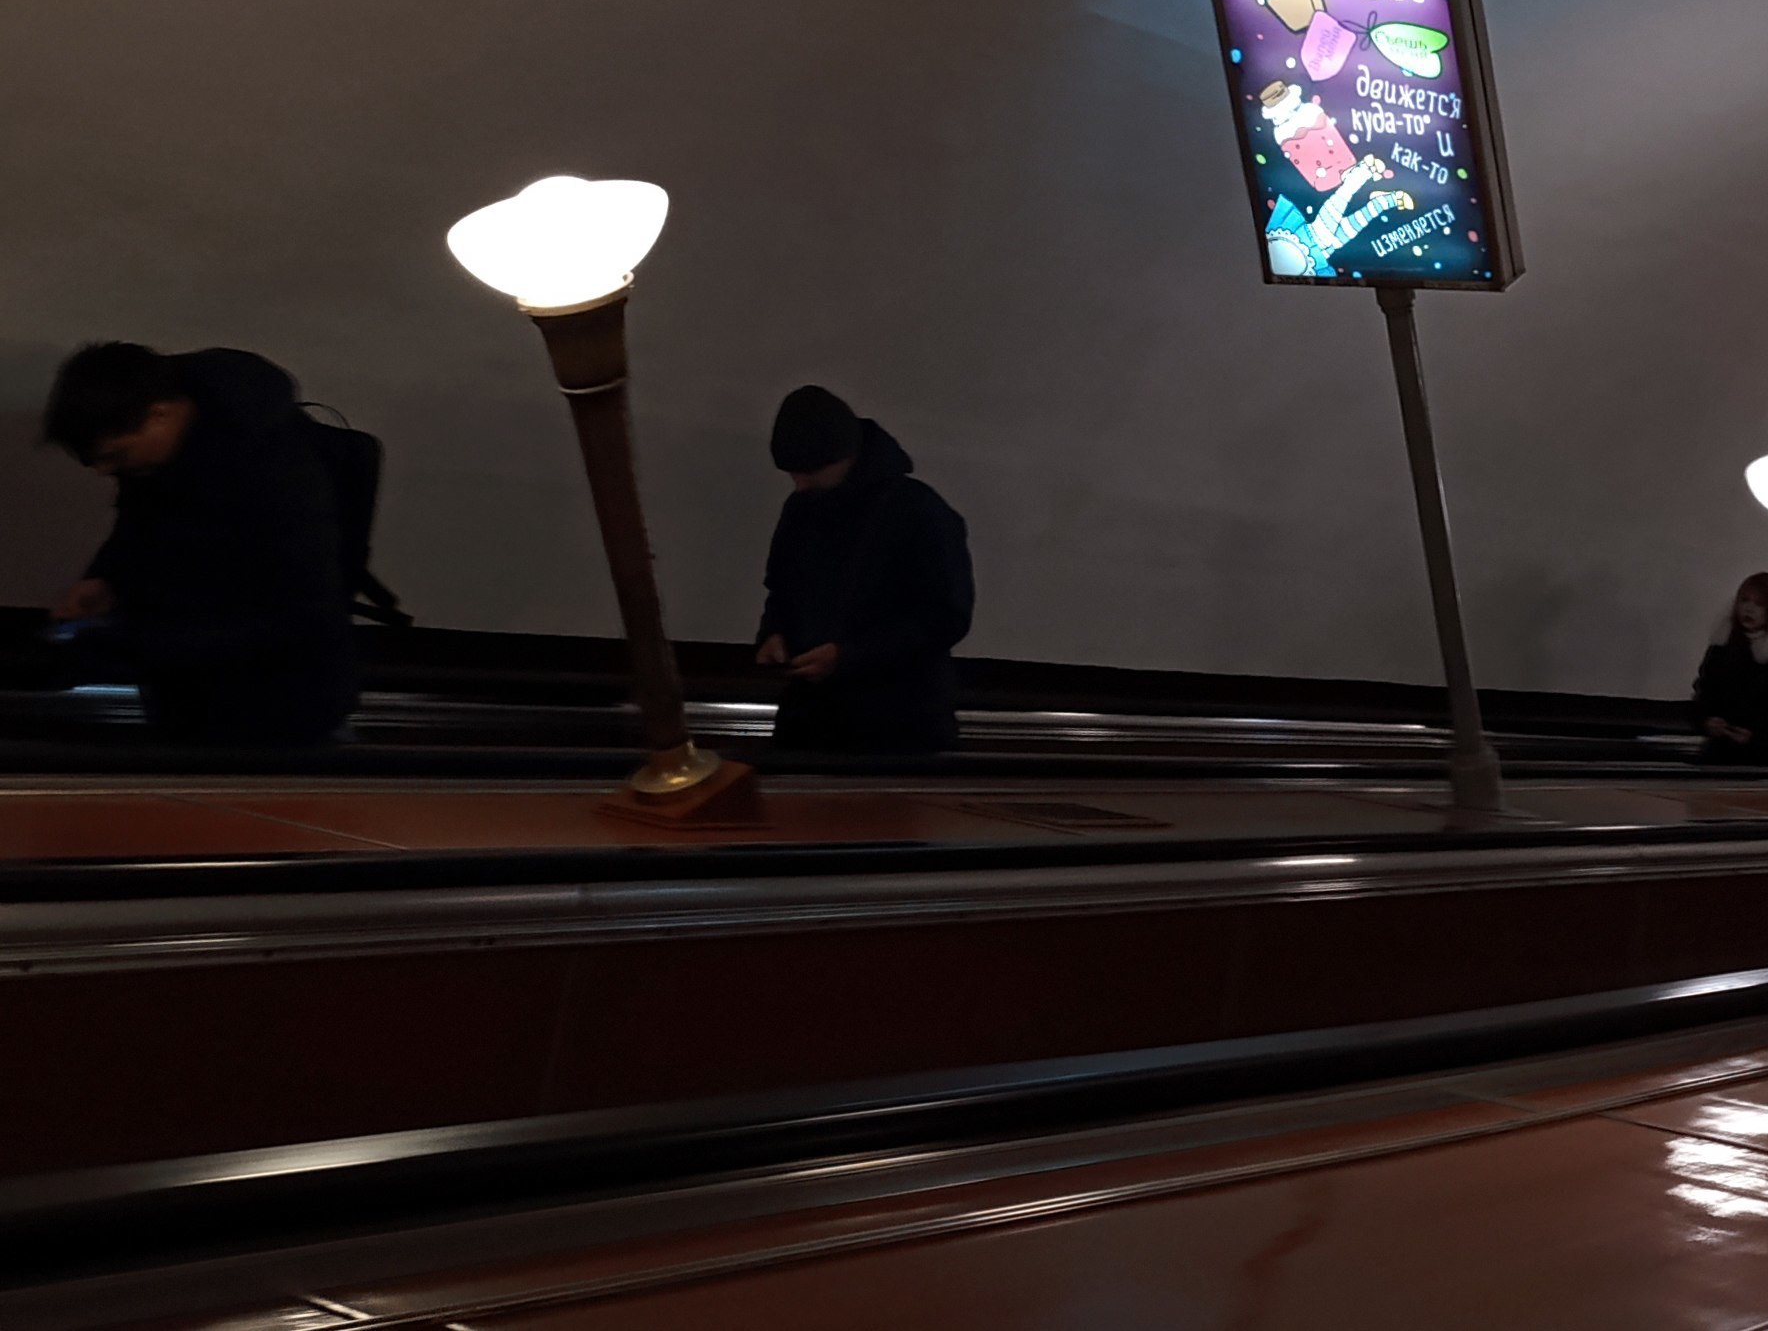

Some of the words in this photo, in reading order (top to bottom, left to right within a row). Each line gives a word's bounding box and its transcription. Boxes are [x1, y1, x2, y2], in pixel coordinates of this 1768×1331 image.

[1356, 64, 1462, 120] движется
[1351, 102, 1426, 143] куда-то
[1436, 130, 1455, 157] и
[1391, 142, 1449, 185] как-то
[1370, 203, 1456, 258] изменяется
